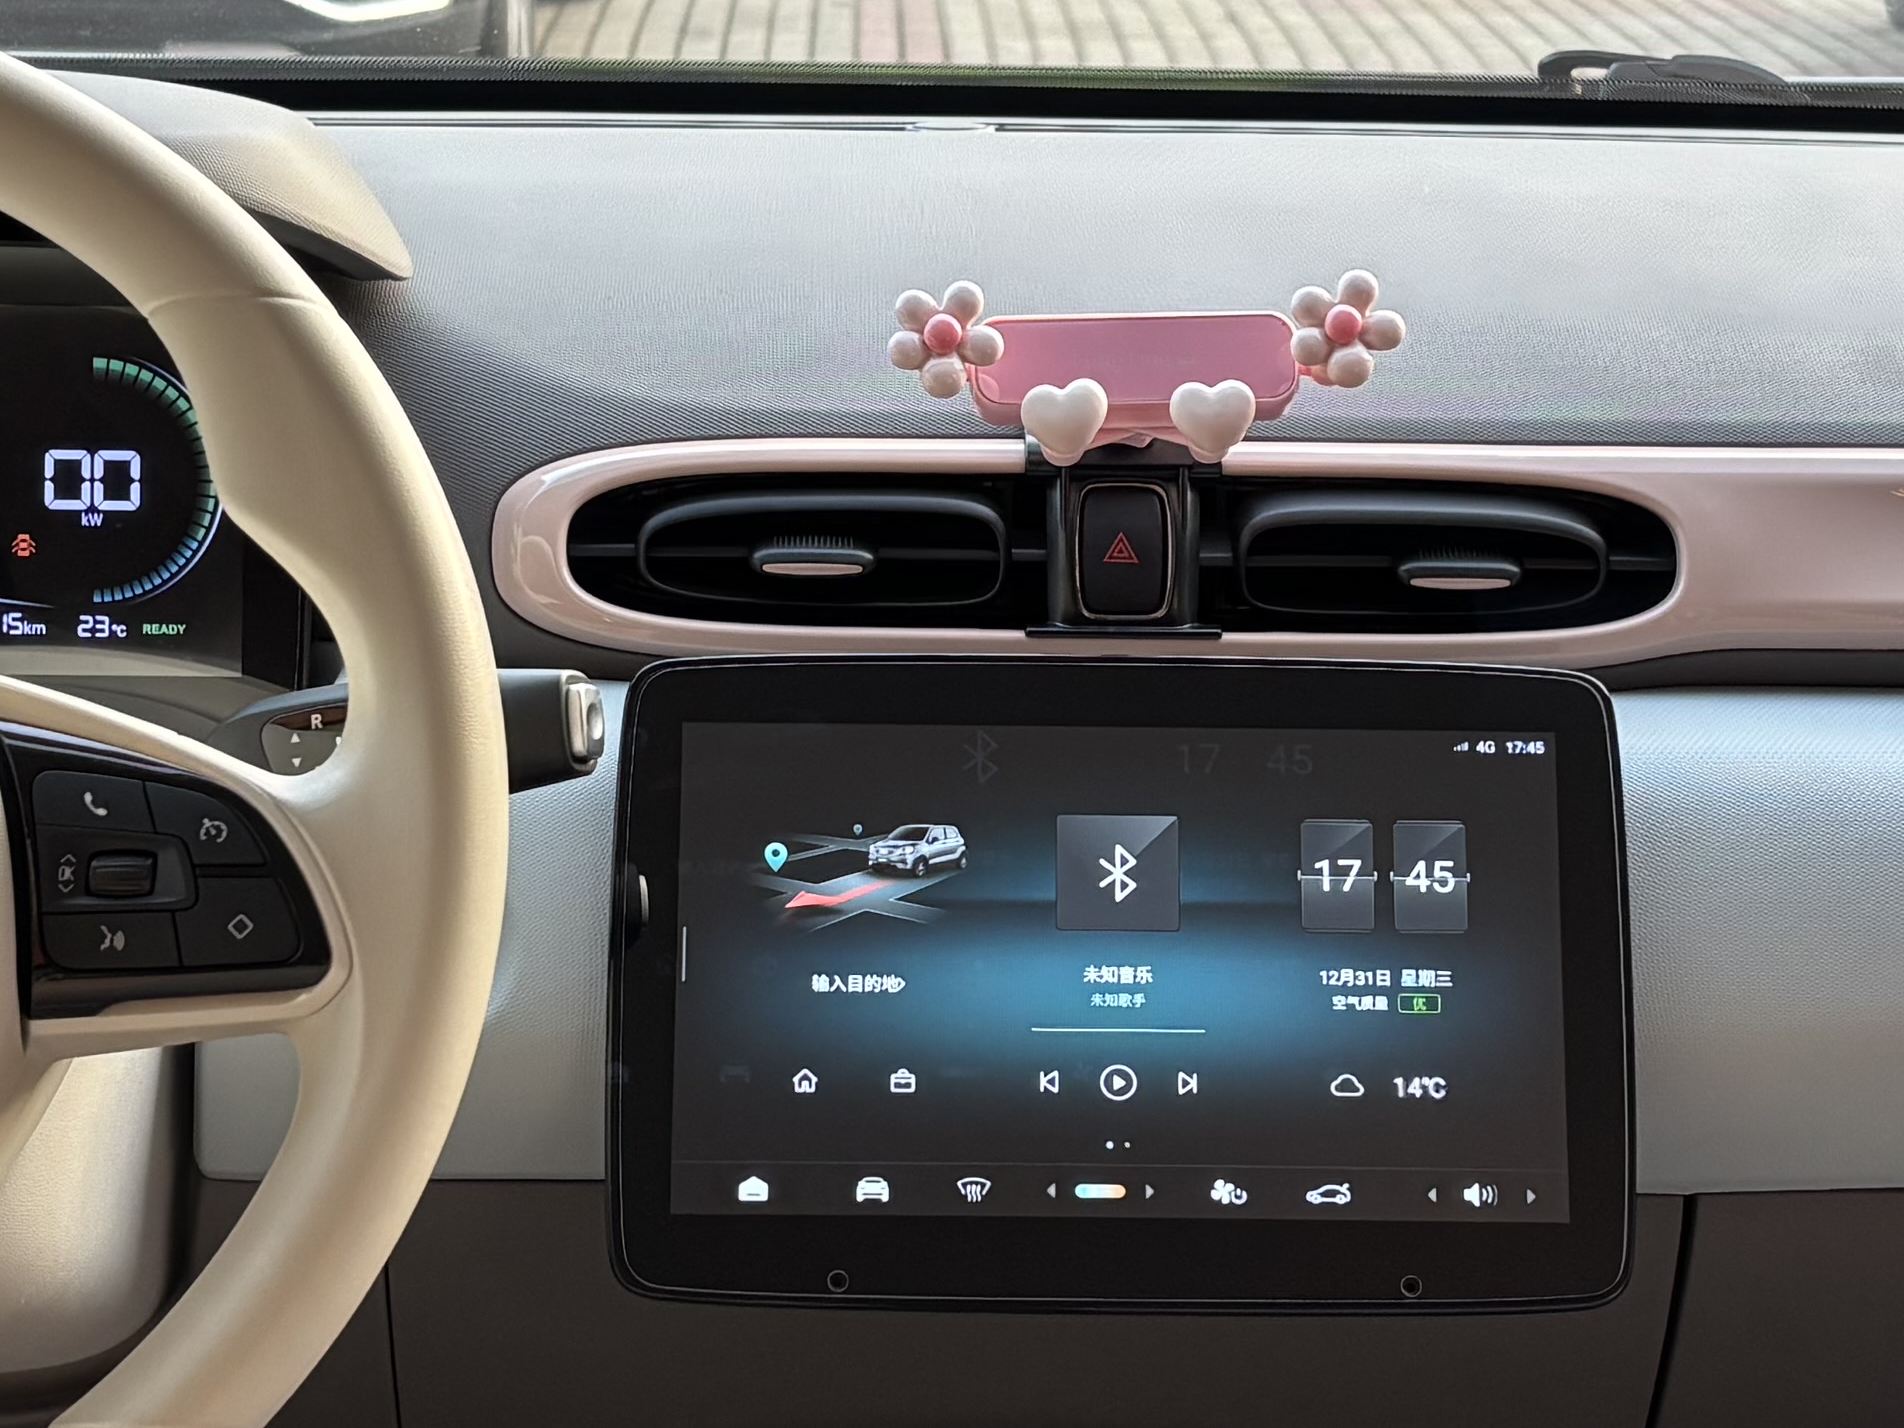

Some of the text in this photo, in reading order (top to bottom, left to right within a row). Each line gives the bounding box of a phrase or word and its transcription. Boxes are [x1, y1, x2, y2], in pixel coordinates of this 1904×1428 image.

[44, 449, 141, 511] 00
[81, 512, 103, 527] kW
[142, 624, 186, 634] READY
[310, 714, 323, 729] R
[1476, 741, 1545, 754] 4G 17:45
[1314, 859, 1455, 893] 17 45
[1083, 965, 1153, 985] 未知音乐
[1319, 969, 1453, 987] 12月31日 星期三
[1090, 993, 1146, 1008] 未知歌手
[1332, 995, 1388, 1011] 空气质量
